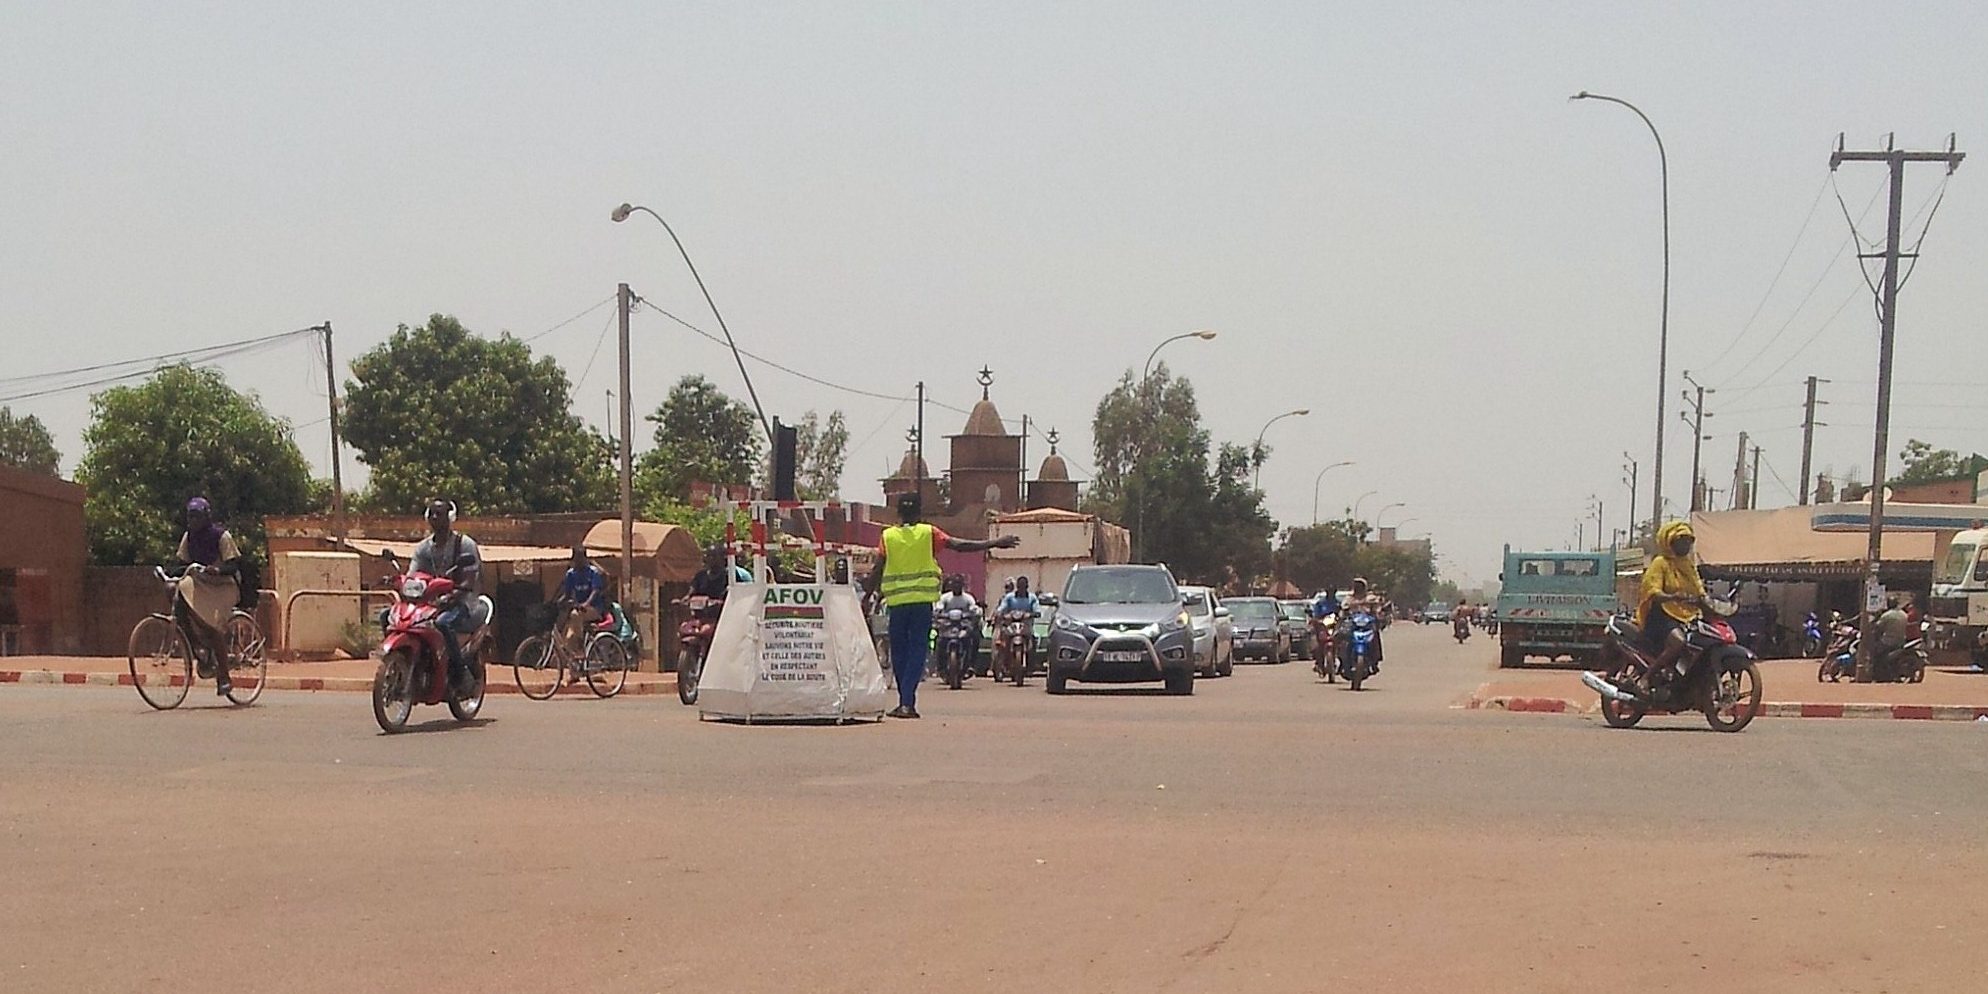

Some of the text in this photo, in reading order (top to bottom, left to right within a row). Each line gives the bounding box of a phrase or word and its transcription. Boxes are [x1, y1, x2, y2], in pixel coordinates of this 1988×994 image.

[763, 588, 824, 604] AFOV
[794, 642, 812, 650] NOTRE
[762, 652, 826, 660] ET CELLE DES AUTRES
[761, 673, 769, 681] LE
[788, 673, 796, 681] DE
[798, 673, 805, 681] LA
